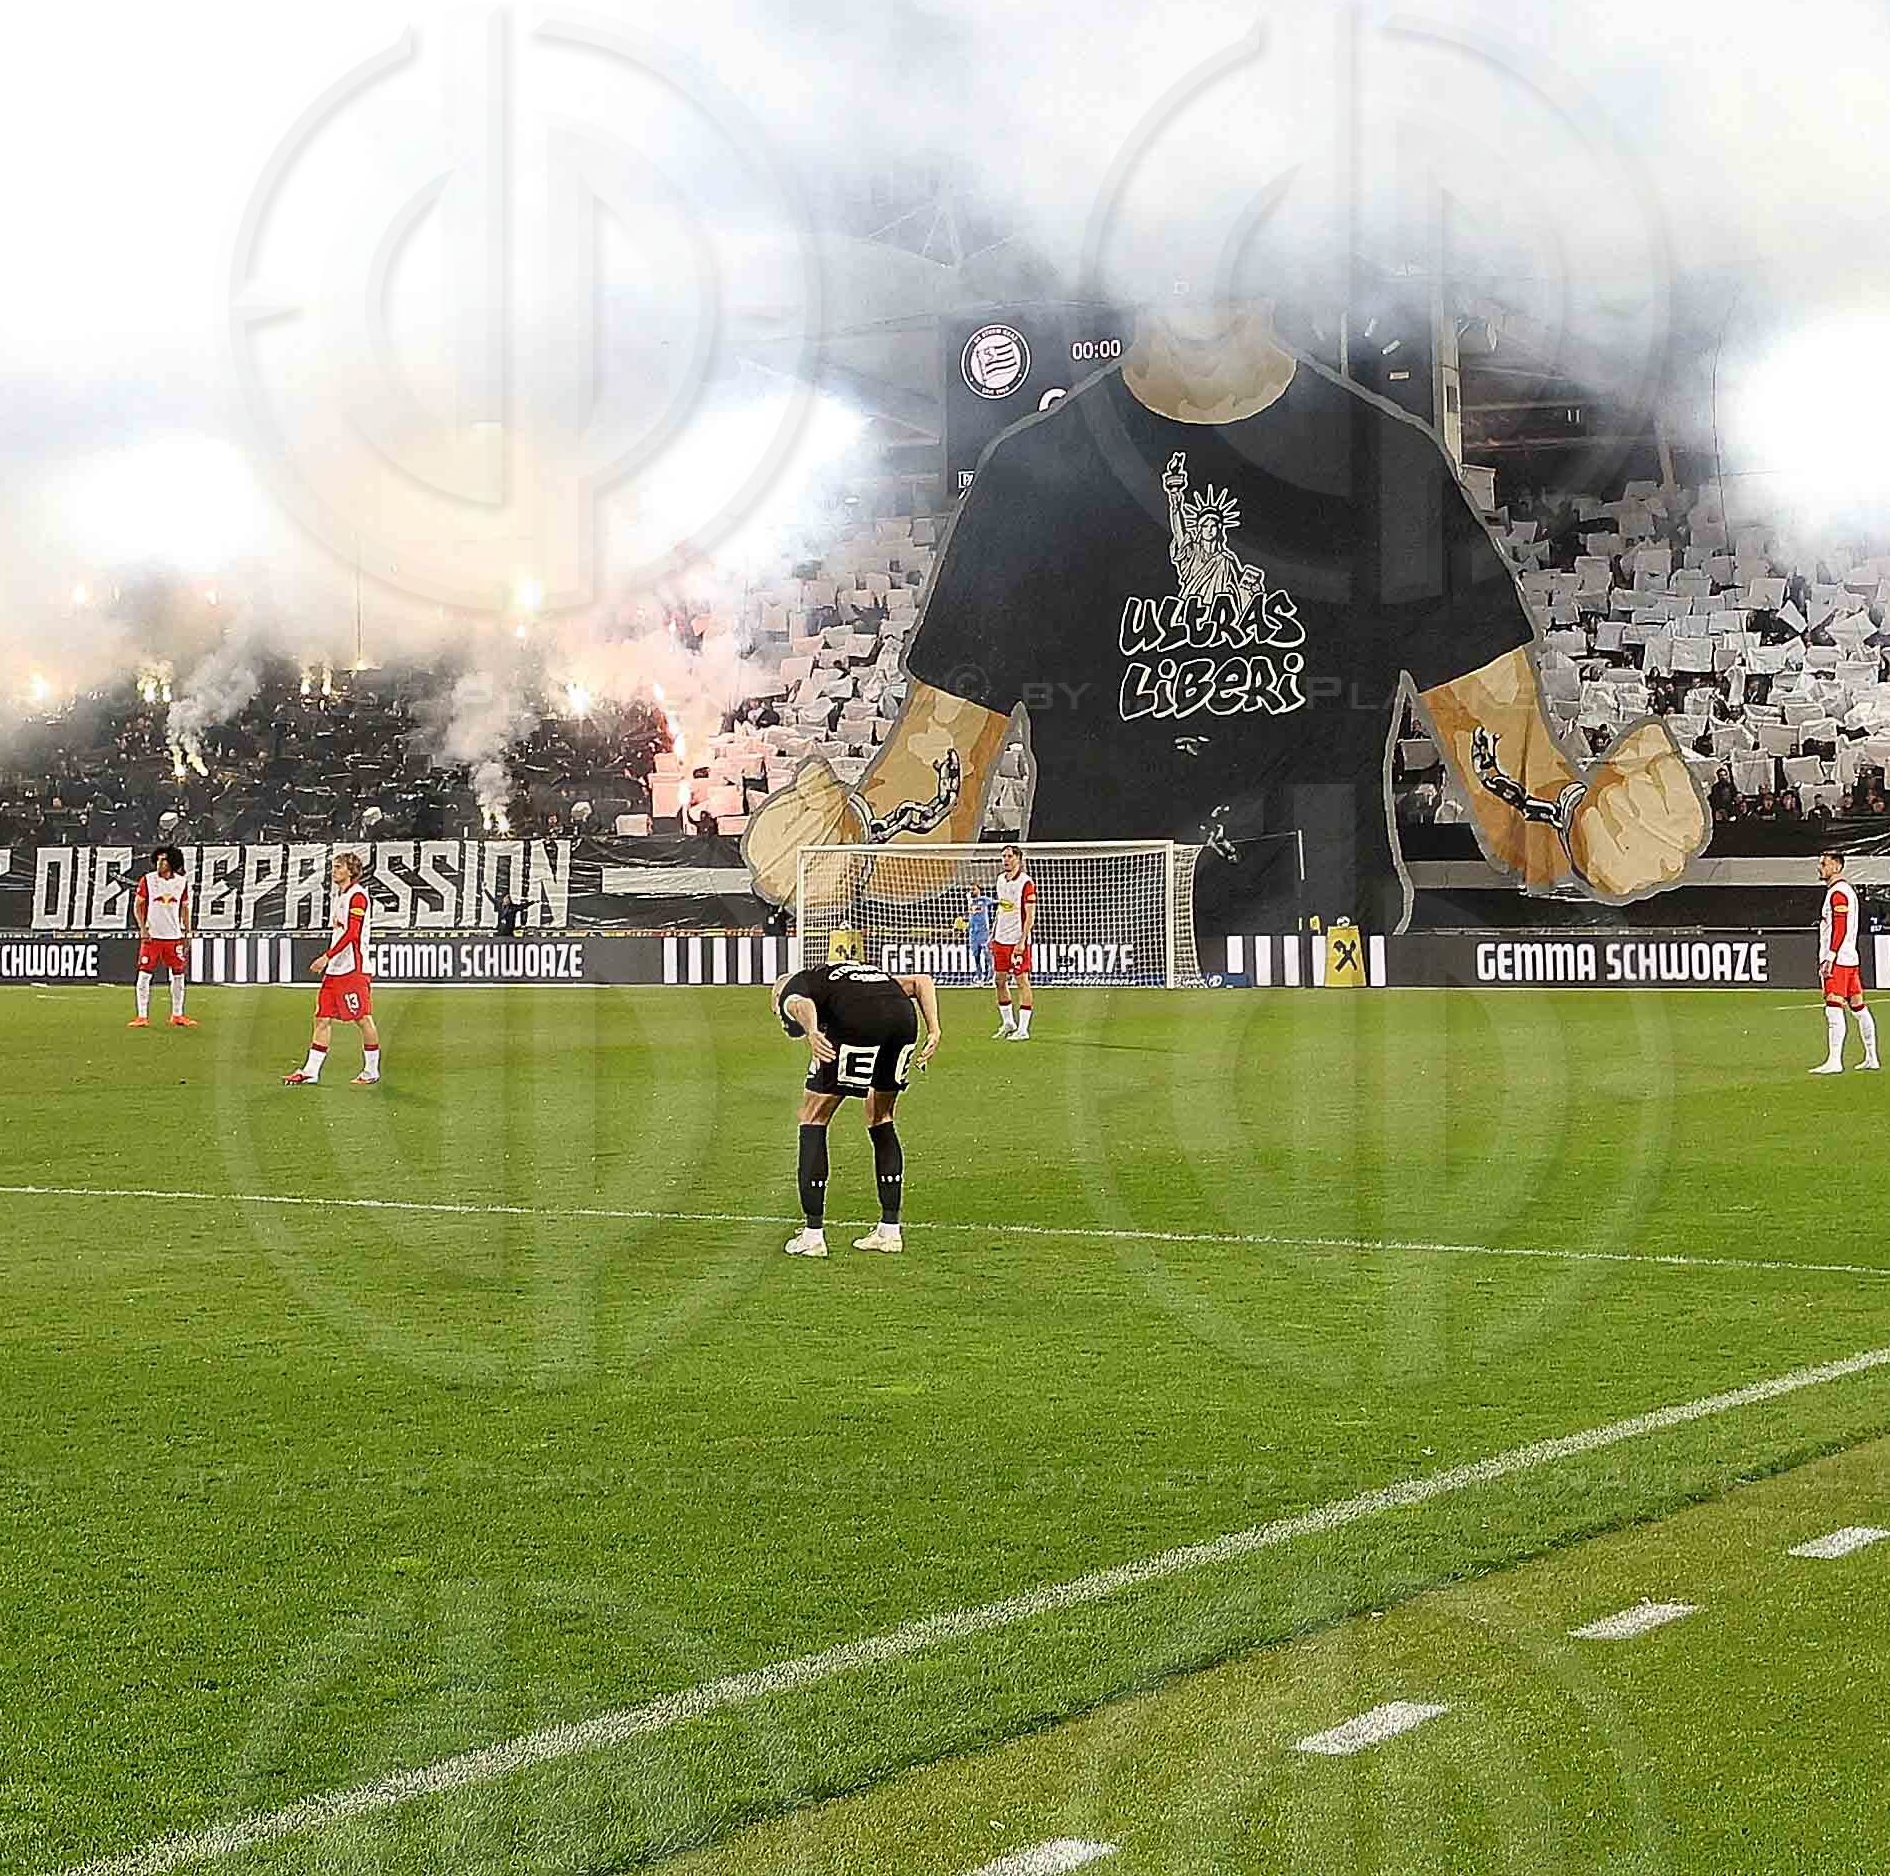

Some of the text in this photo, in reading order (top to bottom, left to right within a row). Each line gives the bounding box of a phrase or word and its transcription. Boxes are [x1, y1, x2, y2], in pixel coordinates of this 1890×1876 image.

[1072, 340, 1121, 360] 00:00
[32, 846, 134, 932] DIE
[177, 839, 571, 930] EPRSSION
[461, 943, 583, 978] SCHWOAZE
[1476, 942, 1769, 982] GEMMA SCHWOAZE
[345, 993, 359, 1009] 13
